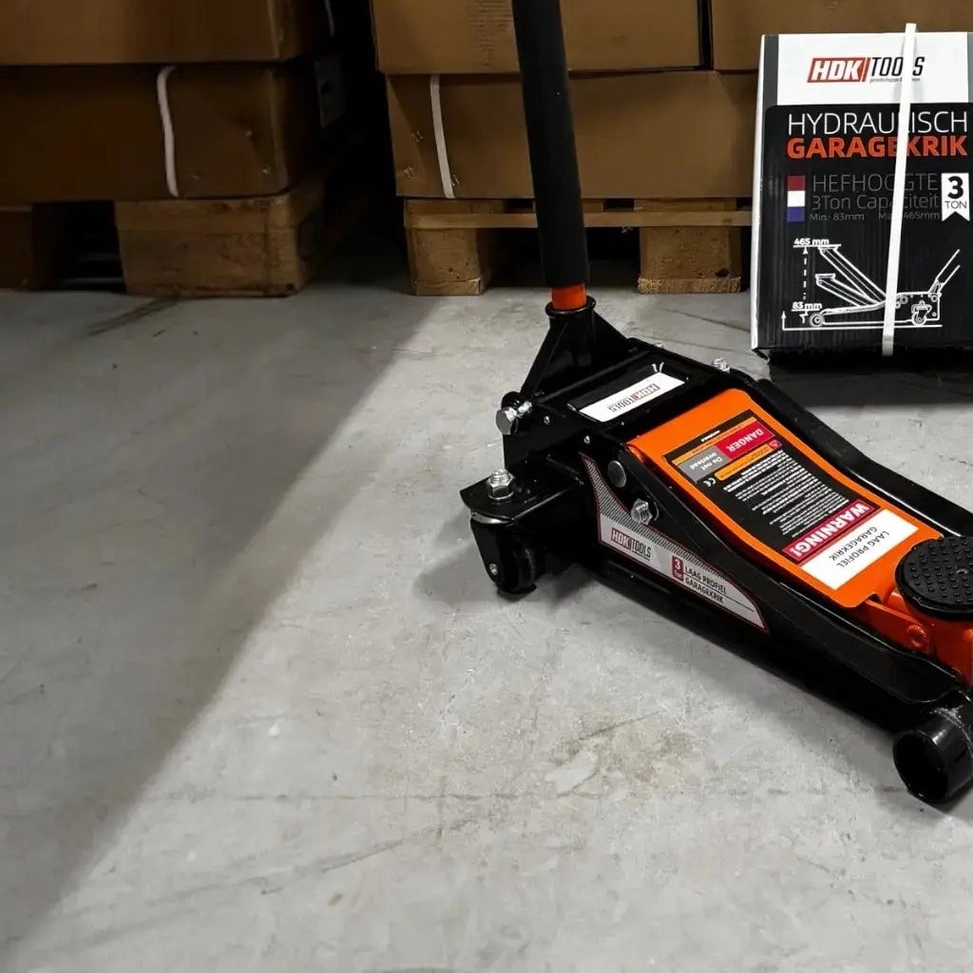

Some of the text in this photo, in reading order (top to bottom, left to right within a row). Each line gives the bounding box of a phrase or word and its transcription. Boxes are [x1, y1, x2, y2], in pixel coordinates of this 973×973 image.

[811, 56, 925, 81] HDK TOOS
[947, 175, 964, 199] 3
[857, 192, 939, 214] Capciteit
[944, 200, 967, 209] TON
[794, 238, 810, 246] 465
[726, 428, 765, 452] DANGER
[789, 503, 870, 557] WARNING!
[612, 528, 651, 558] HDK TOOLS
[829, 526, 878, 561] GARAGEKRIK
[836, 530, 890, 568] LAAG PROFIEL
[674, 558, 681, 570] 3
[685, 566, 701, 580] LAAG
[702, 574, 727, 594] PROFIEL
